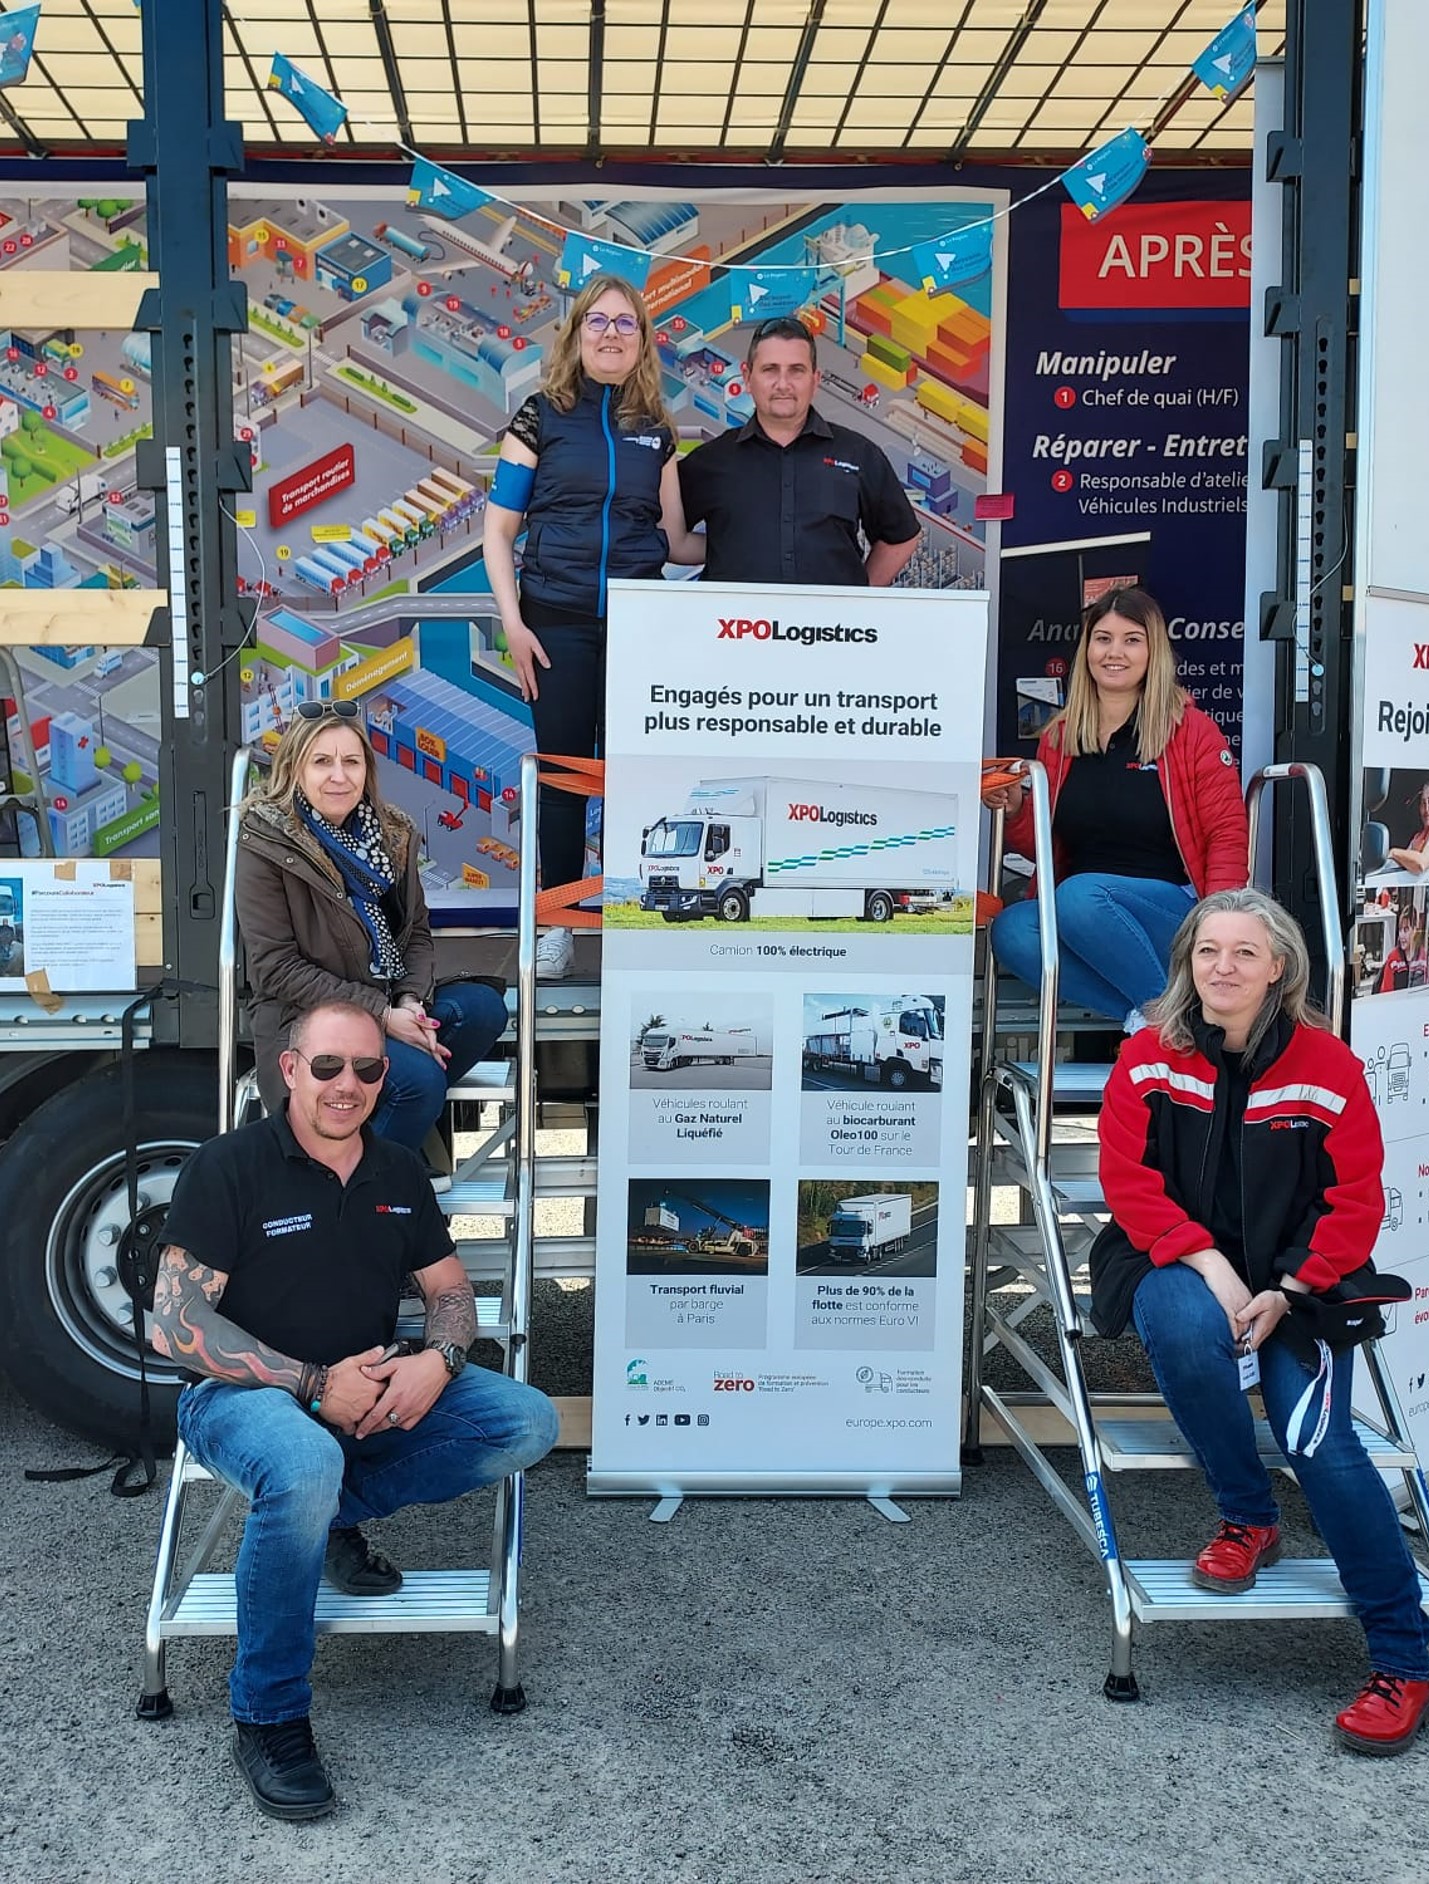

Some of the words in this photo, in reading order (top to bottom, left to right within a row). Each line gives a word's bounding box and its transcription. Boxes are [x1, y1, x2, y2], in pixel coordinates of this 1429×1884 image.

[1035, 350, 1176, 381] Manipuler
[1082, 389, 1125, 406] Chef
[1129, 390, 1150, 406] de
[1154, 390, 1192, 410] quai
[1196, 388, 1239, 408] (H/F)
[1033, 434, 1141, 465] Réparer
[1163, 433, 1248, 458] Entret
[281, 474, 321, 503] Transport
[322, 458, 350, 480] routier
[1080, 473, 1186, 492] Responsable
[282, 503, 293, 514] de
[294, 470, 350, 507] marchandises
[1079, 497, 1157, 514] Véhicules
[1161, 497, 1248, 514] Industriels
[716, 618, 878, 645] XPOLogistics
[1168, 617, 1244, 639] Conse
[345, 650, 408, 694] Déménagement
[1210, 662, 1226, 676] et
[1212, 683, 1233, 699] de
[650, 684, 742, 710] Engagés
[748, 689, 798, 711] pour
[804, 691, 830, 708] un
[837, 690, 938, 714] transport
[644, 711, 690, 734] plus
[697, 714, 828, 736] responsable
[835, 718, 855, 734] et
[862, 717, 942, 737] durable
[788, 803, 878, 827] XPOLogistics
[105, 818, 143, 845] Transport
[707, 865, 724, 875] XPO
[709, 944, 753, 956] Camion
[756, 945, 786, 957] 100%
[789, 945, 847, 959] électrique
[652, 1098, 705, 1110] Véhicules
[708, 1098, 748, 1110] roulant
[827, 1100, 875, 1112] Véhicule
[876, 1100, 916, 1112] roulant
[658, 1115, 673, 1125] au
[675, 1113, 697, 1125] Gaz
[700, 1113, 742, 1124] Naturel
[827, 1117, 841, 1126] au
[843, 1115, 916, 1127] biocarburant
[676, 1127, 723, 1141] Liquéfié
[830, 1129, 878, 1141] Oleo100
[880, 1132, 898, 1142] sur
[899, 1130, 911, 1142] le
[829, 1144, 855, 1156] Tour
[856, 1145, 871, 1156] de
[873, 1145, 913, 1156] France
[262, 1213, 313, 1230] CONDUCTEUR
[266, 1222, 312, 1238] FORMATEUR
[650, 1284, 706, 1296] Transport
[709, 1283, 744, 1295] fluvial
[817, 1285, 843, 1297] Plus
[845, 1285, 860, 1297] de
[862, 1285, 886, 1297] 90%
[887, 1285, 902, 1297] de
[904, 1285, 915, 1297] la
[670, 1301, 687, 1311] par
[688, 1299, 724, 1311] barge
[812, 1299, 843, 1311] flotte
[845, 1302, 863, 1311] est
[865, 1300, 919, 1312] conforme
[677, 1314, 684, 1324] à
[687, 1313, 715, 1324] Paris
[811, 1316, 831, 1325] aux
[834, 1316, 876, 1326] normes
[879, 1315, 907, 1326] Euro
[908, 1315, 919, 1326] VI
[713, 1379, 755, 1392] zero
[846, 1418, 933, 1430] europe.xpo.com
[1089, 1492, 1110, 1560] TUBESCA
